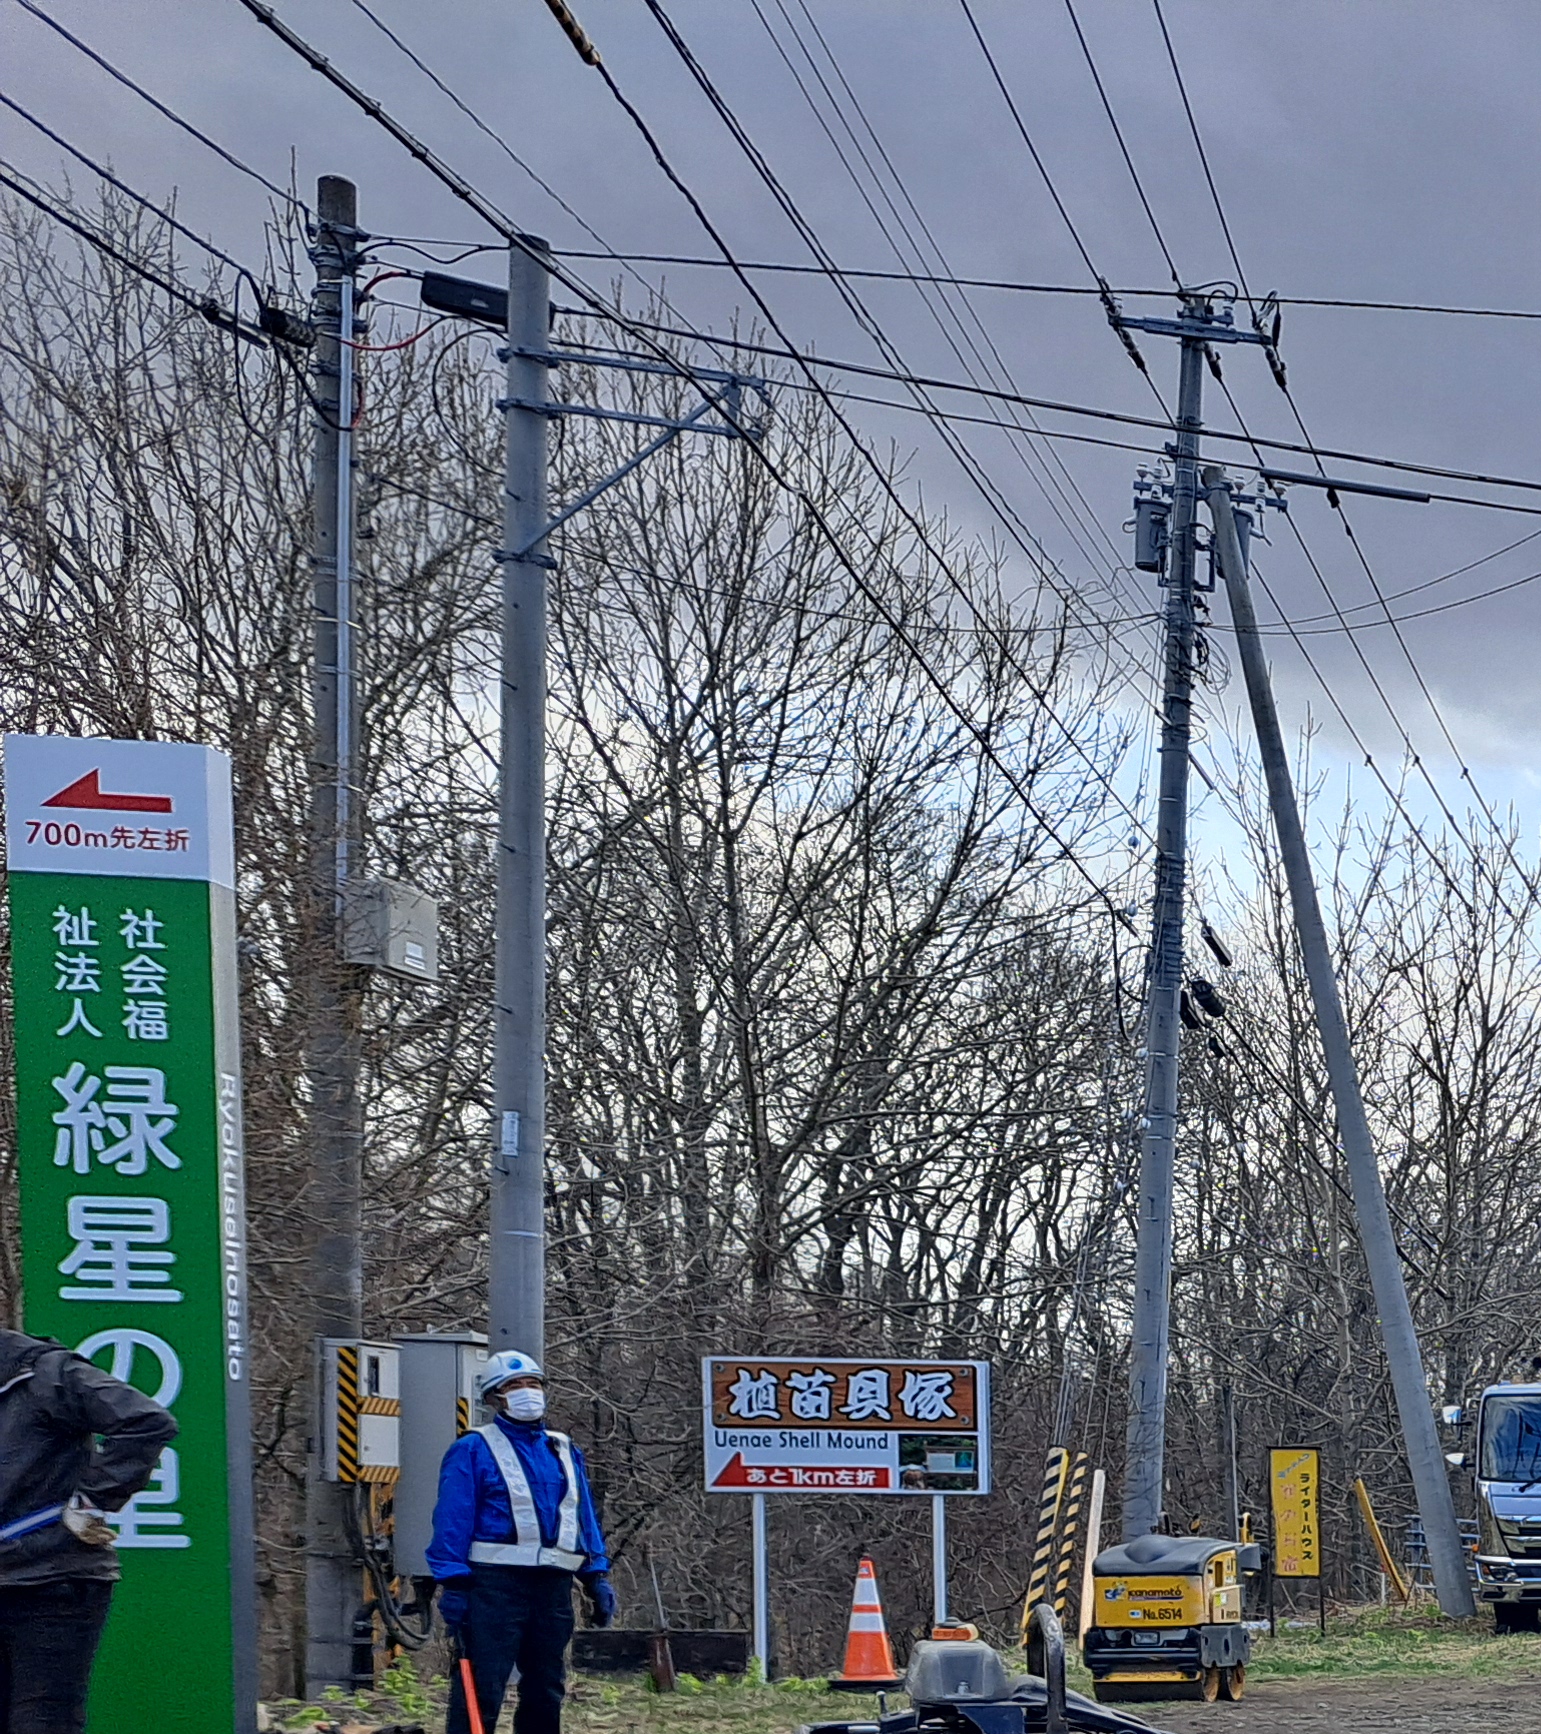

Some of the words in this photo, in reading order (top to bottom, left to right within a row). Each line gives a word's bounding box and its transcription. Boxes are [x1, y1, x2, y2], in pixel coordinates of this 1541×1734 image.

[25, 820, 190, 852] 700m先左折
[52, 904, 103, 1038] 祉法人
[119, 908, 170, 1041] 社会福
[727, 1367, 957, 1421] 植苗貝塚
[714, 1430, 772, 1448] Uenae
[779, 1431, 821, 1449] Shell
[827, 1432, 889, 1450] Mound
[745, 1468, 877, 1487] あと1km左折
[1300, 1472, 1314, 1560] ライターハウス
